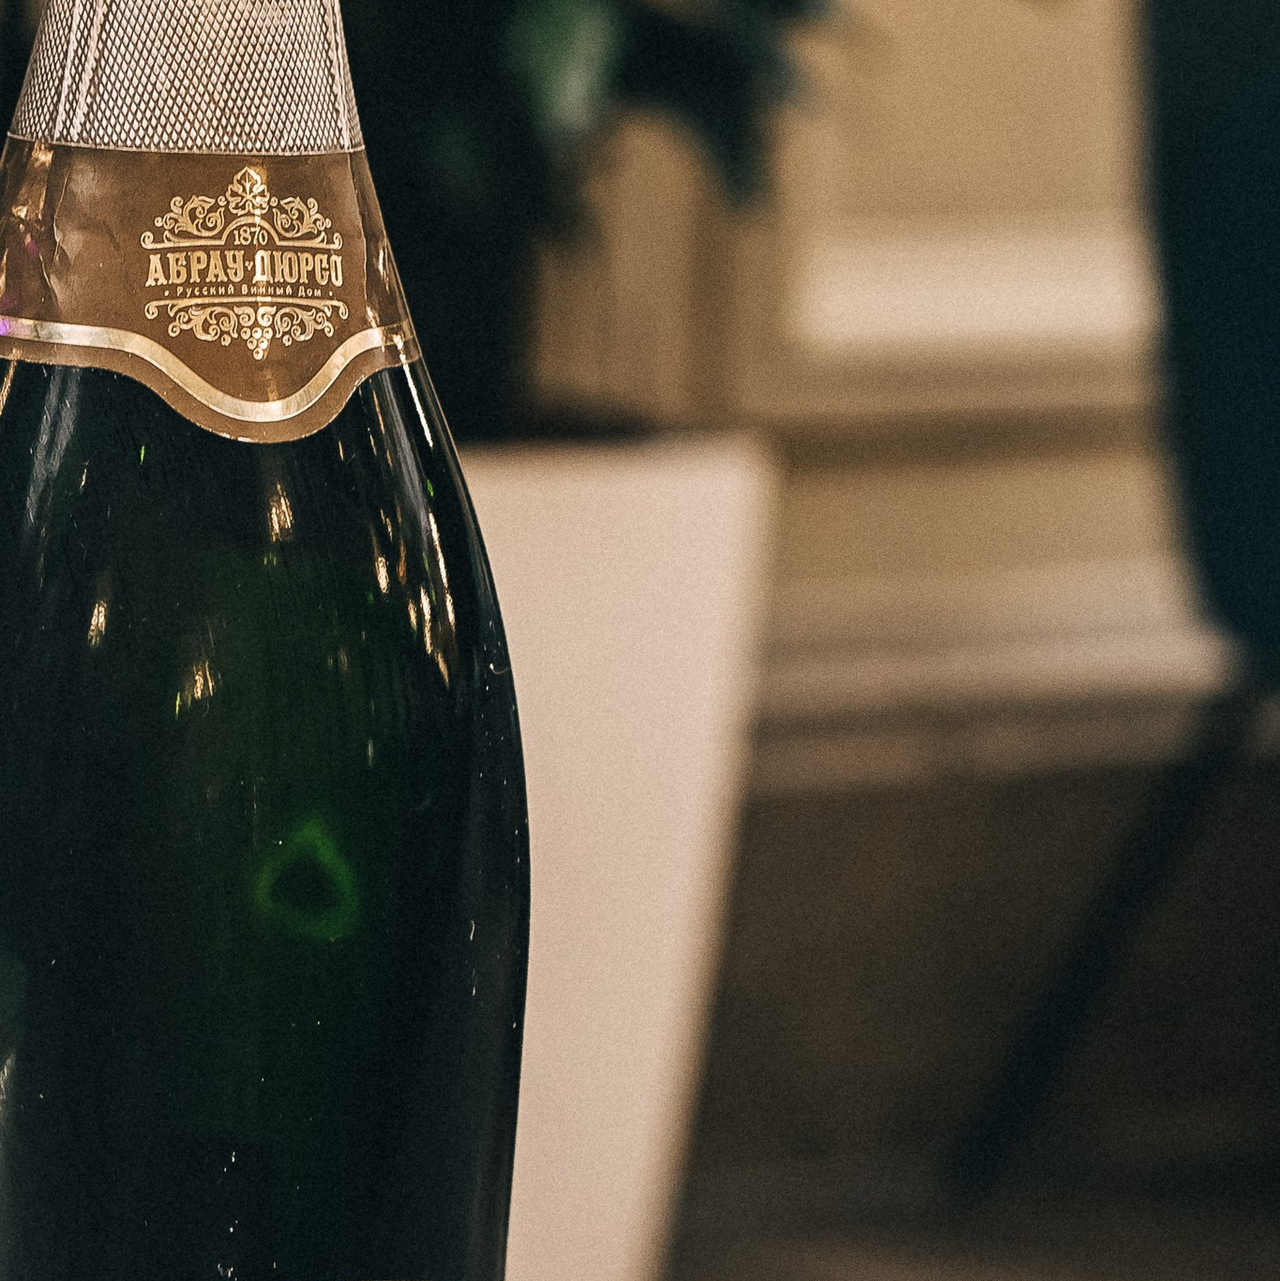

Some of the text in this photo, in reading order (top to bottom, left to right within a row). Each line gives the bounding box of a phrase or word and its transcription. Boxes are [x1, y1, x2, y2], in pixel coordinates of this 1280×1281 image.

[233, 229, 268, 245] 1870
[176, 285, 235, 297] Русский
[297, 285, 322, 297] Дом
